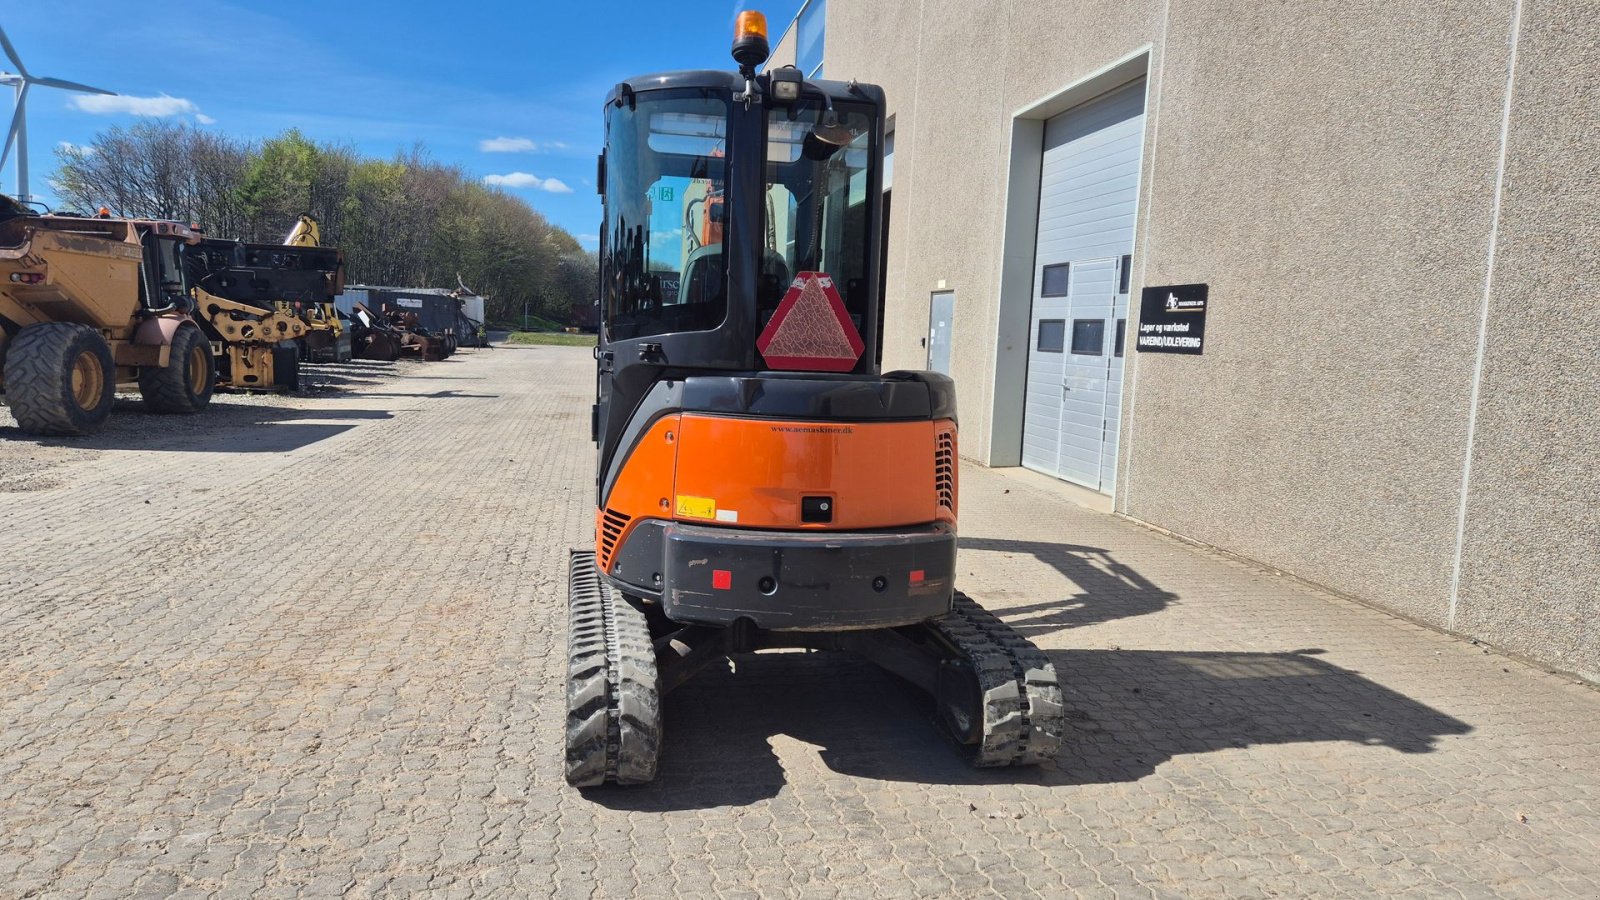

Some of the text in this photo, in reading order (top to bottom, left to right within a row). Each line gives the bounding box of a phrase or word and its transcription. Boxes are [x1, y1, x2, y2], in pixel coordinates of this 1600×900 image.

[1140, 322, 1190, 333] Lager og værksted
[771, 425, 853, 434] www.aemaskiner.dk
